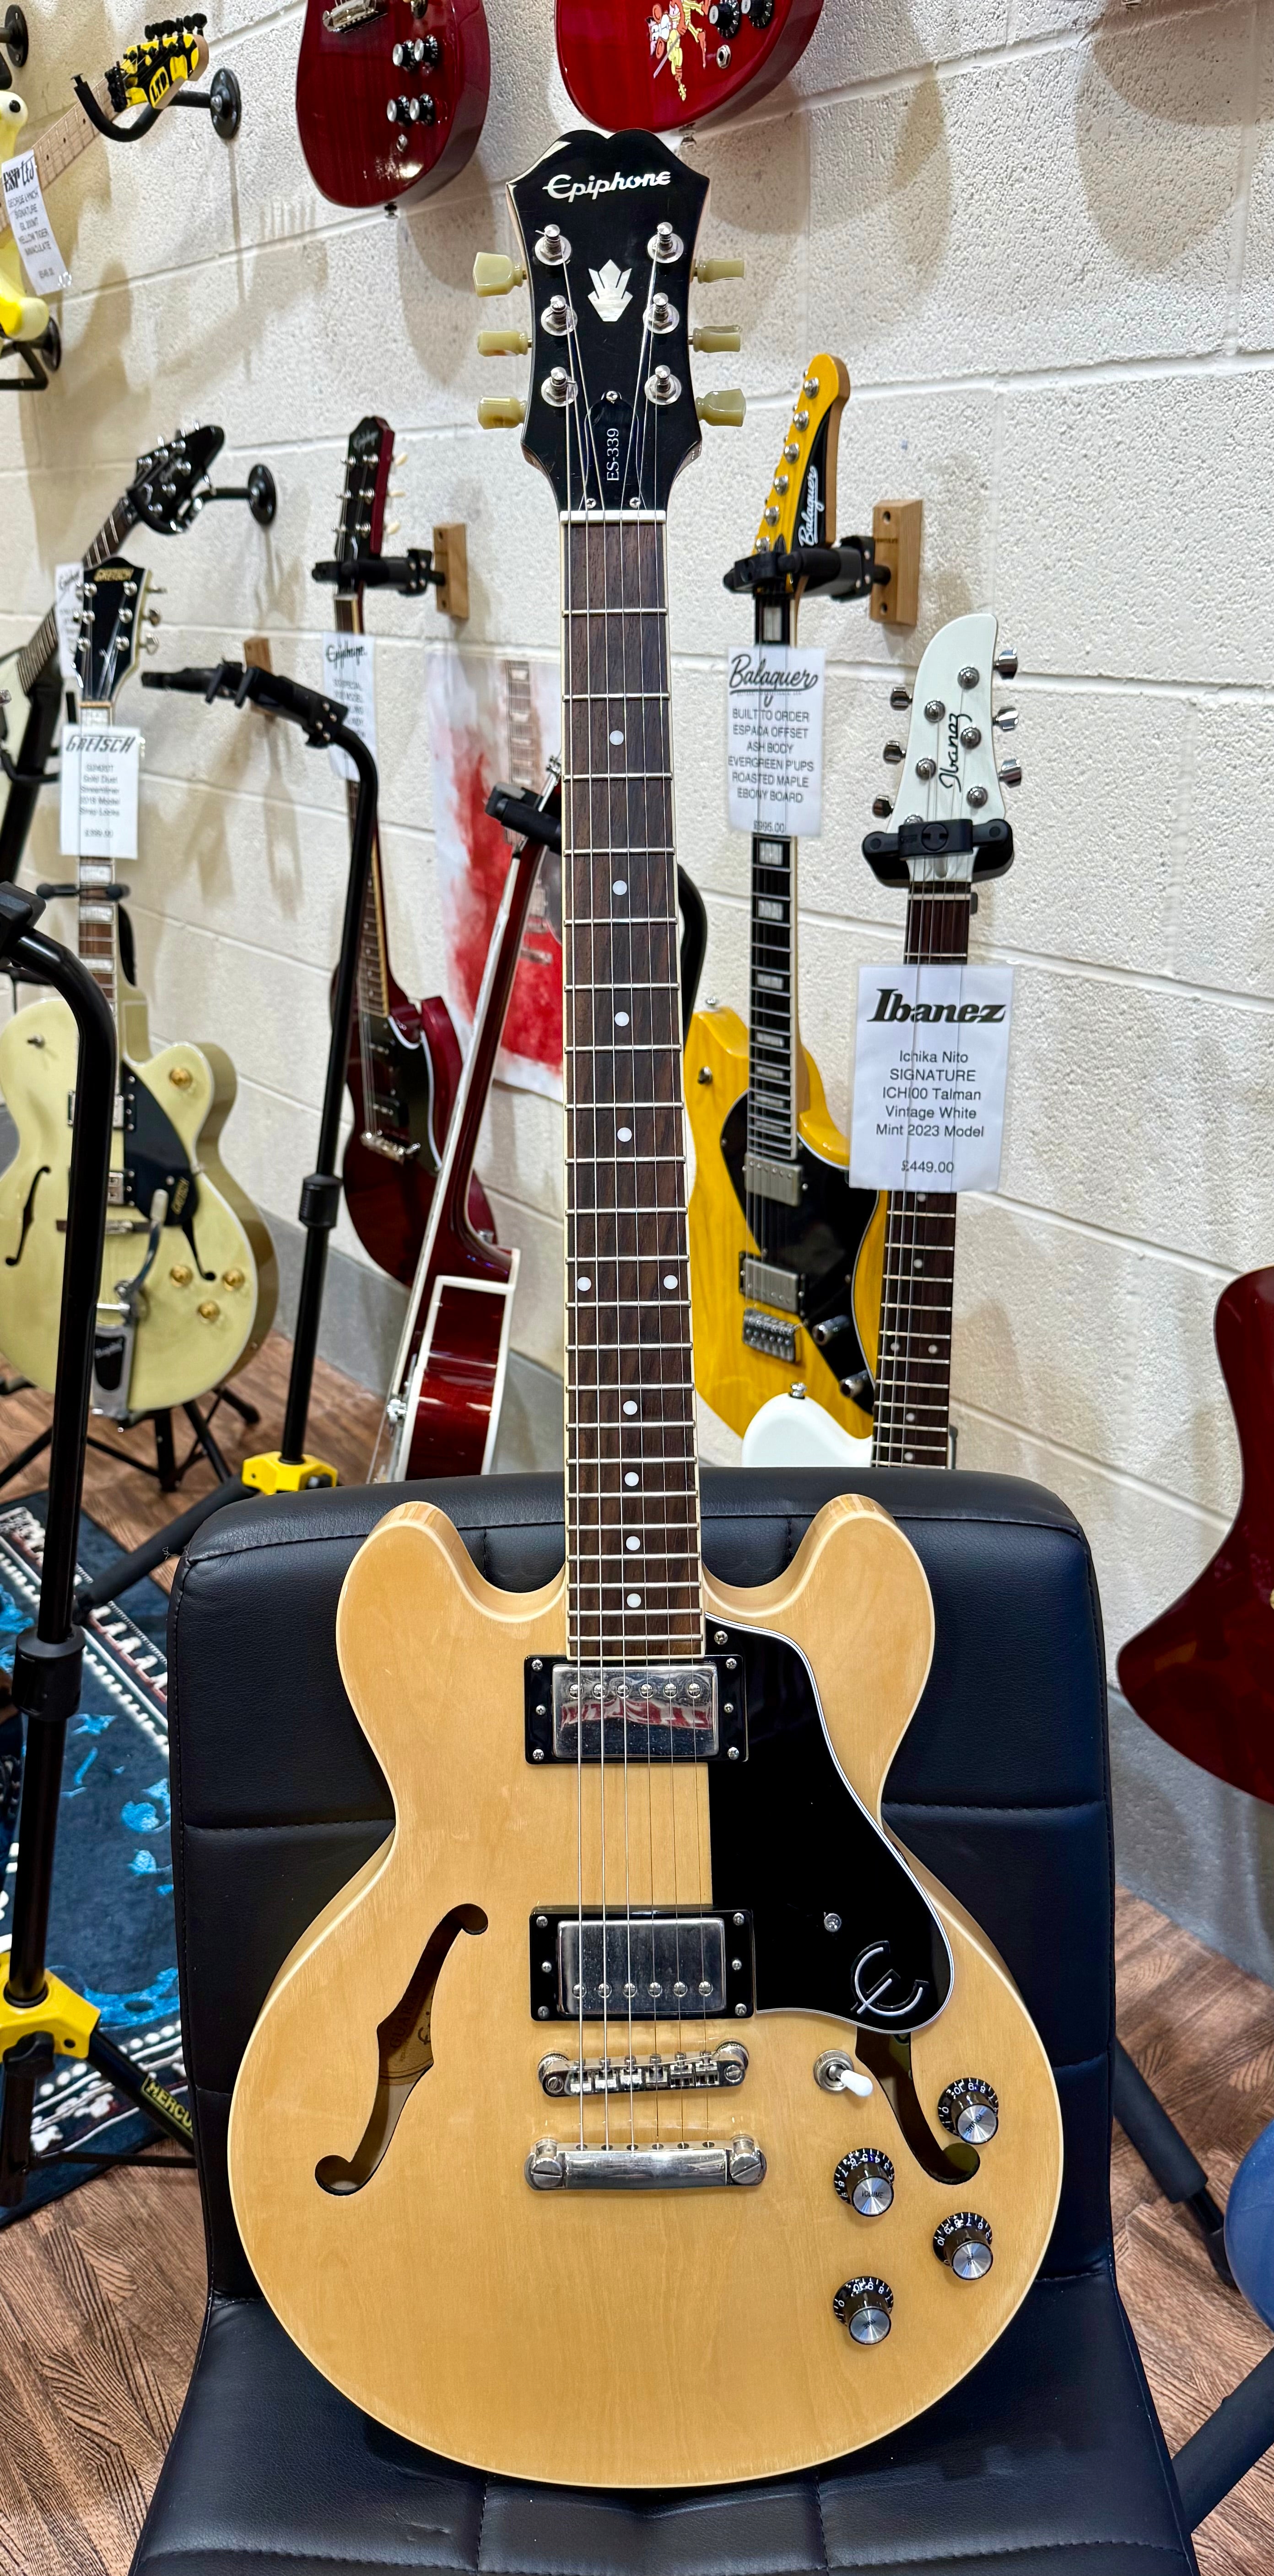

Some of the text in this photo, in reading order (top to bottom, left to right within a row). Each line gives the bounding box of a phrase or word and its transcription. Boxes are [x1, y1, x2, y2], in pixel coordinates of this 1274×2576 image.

[151, 71, 167, 103] LTD
[542, 171, 671, 203] Epiphone
[607, 428, 619, 480] ES-339
[798, 464, 825, 547] Balaguer
[729, 654, 818, 707] Balaguer
[732, 708, 810, 722] BUILT TO ORDER
[733, 724, 809, 738] ESPADA OFFSET
[65, 735, 135, 754] GRETSCH
[747, 742, 794, 754] ASH BODY
[939, 713, 972, 792] Ibanez
[728, 756, 815, 772] EVERGREEN P'UPS
[732, 771, 809, 788] ROASTED MAPLE
[737, 787, 804, 803] EBONY BOARD
[867, 988, 1006, 1023] Ibanez
[900, 1050, 968, 1063] Ichika Nito
[890, 1068, 976, 1082] SIGNATURE
[932, 1088, 981, 1100] Talman
[885, 1105, 977, 1121] Vintage White
[876, 1124, 984, 1137] Mint 2023 Model
[901, 1160, 954, 1173] £449.00
[146, 2080, 193, 2132] MERCU
